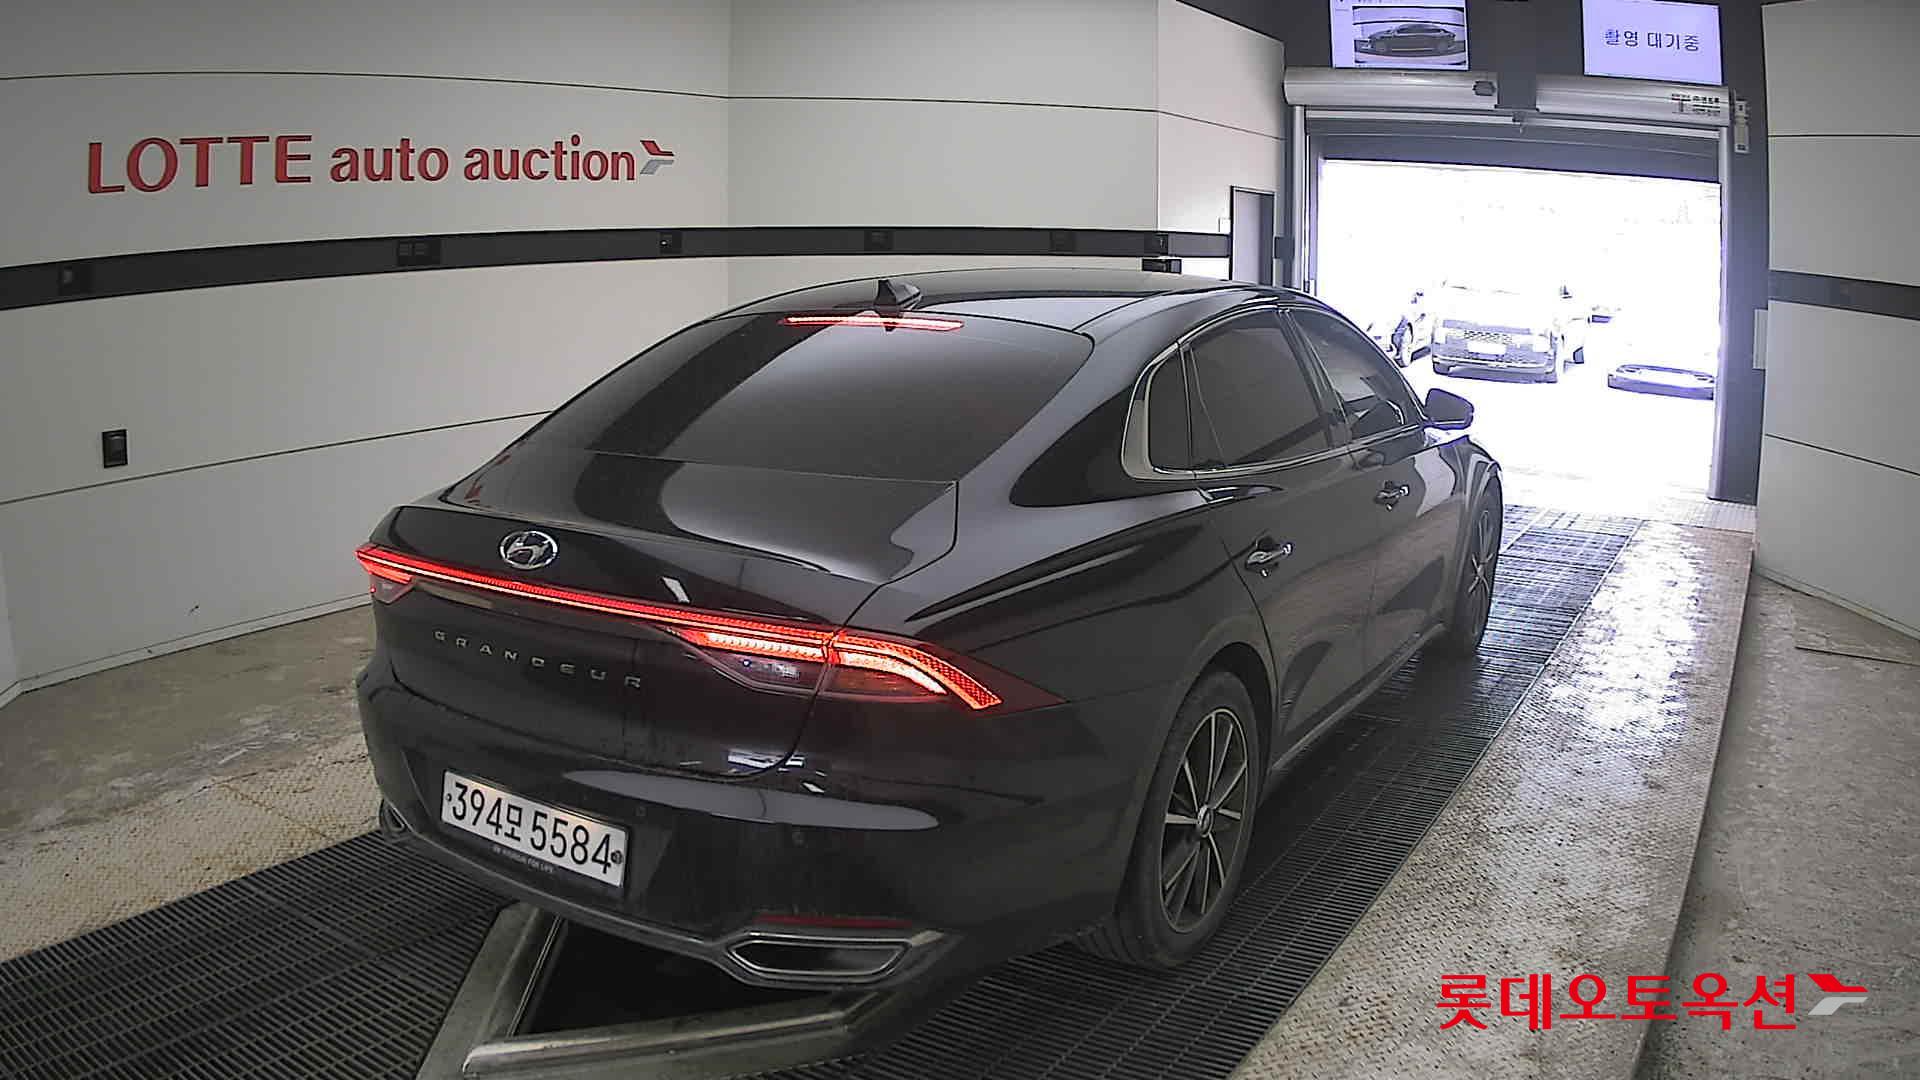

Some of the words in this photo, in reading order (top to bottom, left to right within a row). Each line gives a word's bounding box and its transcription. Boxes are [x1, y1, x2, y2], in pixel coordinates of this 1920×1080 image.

[1647, 32, 1699, 52] 대기중
[88, 135, 312, 194] LOTTE
[329, 138, 449, 182] auto
[463, 134, 635, 182] auction
[434, 630, 642, 689] GRANDEUR
[451, 781, 523, 842] 394모
[530, 811, 614, 874] 5584
